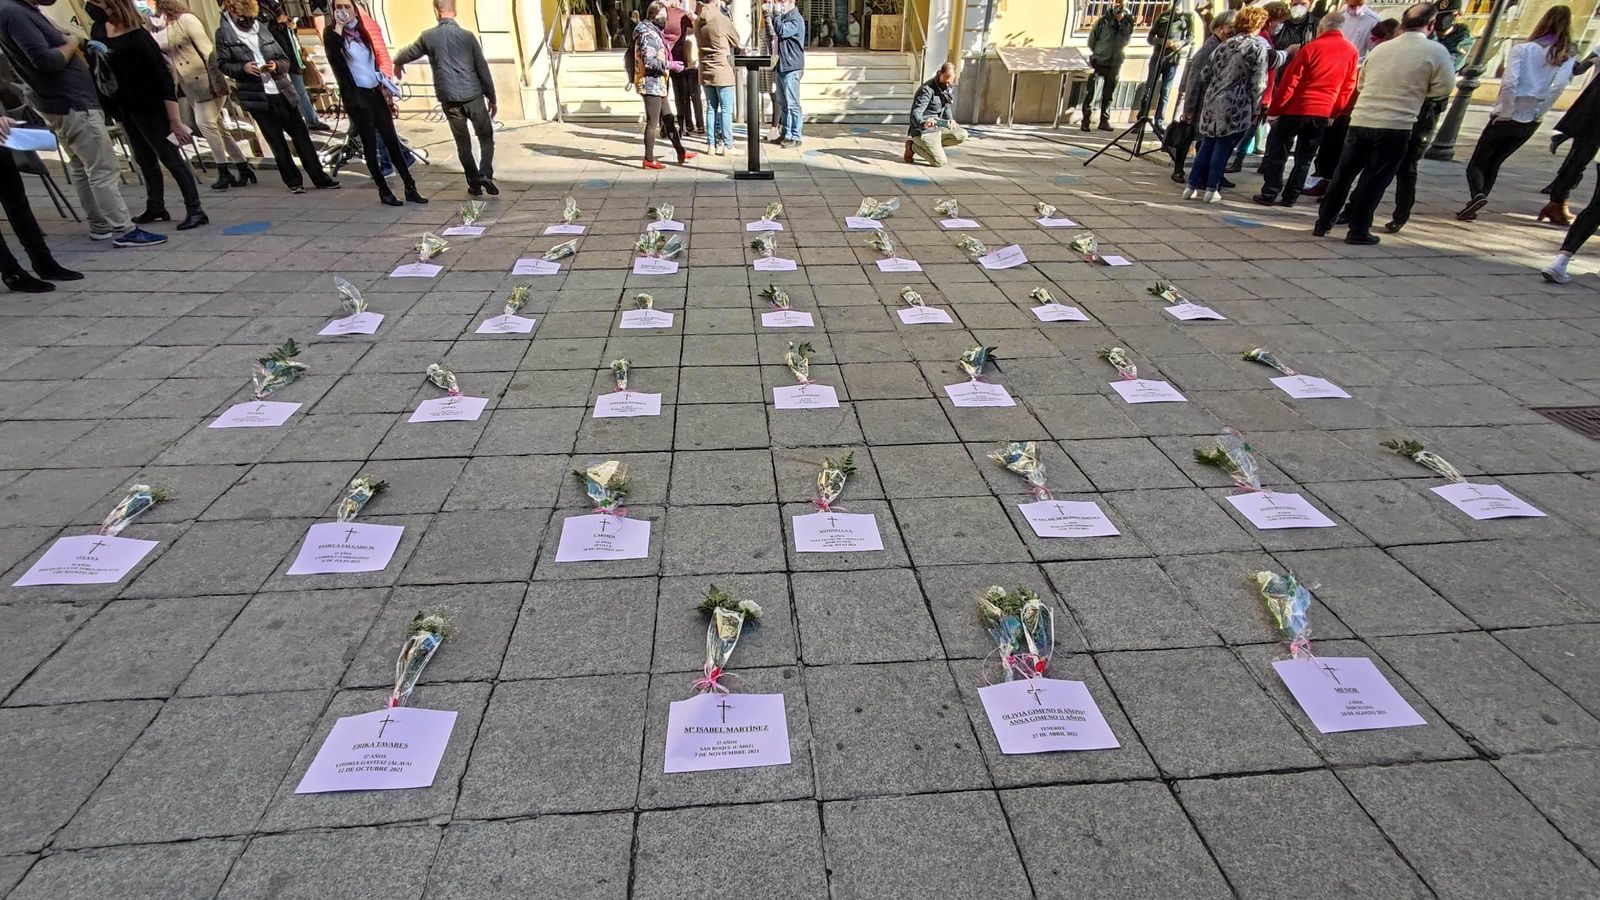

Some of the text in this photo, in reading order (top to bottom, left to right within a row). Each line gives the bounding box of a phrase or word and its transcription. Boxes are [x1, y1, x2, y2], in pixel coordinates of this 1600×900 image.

[1002, 710, 1026, 720] OLIVIA
[1028, 708, 1056, 716] GIMENO
[1010, 718, 1029, 726] ANNA
[726, 725, 768, 733] MARTÍNEZ
[353, 742, 374, 750] ERIKA
[336, 760, 388, 768] VITORIA-GASTEIZ
